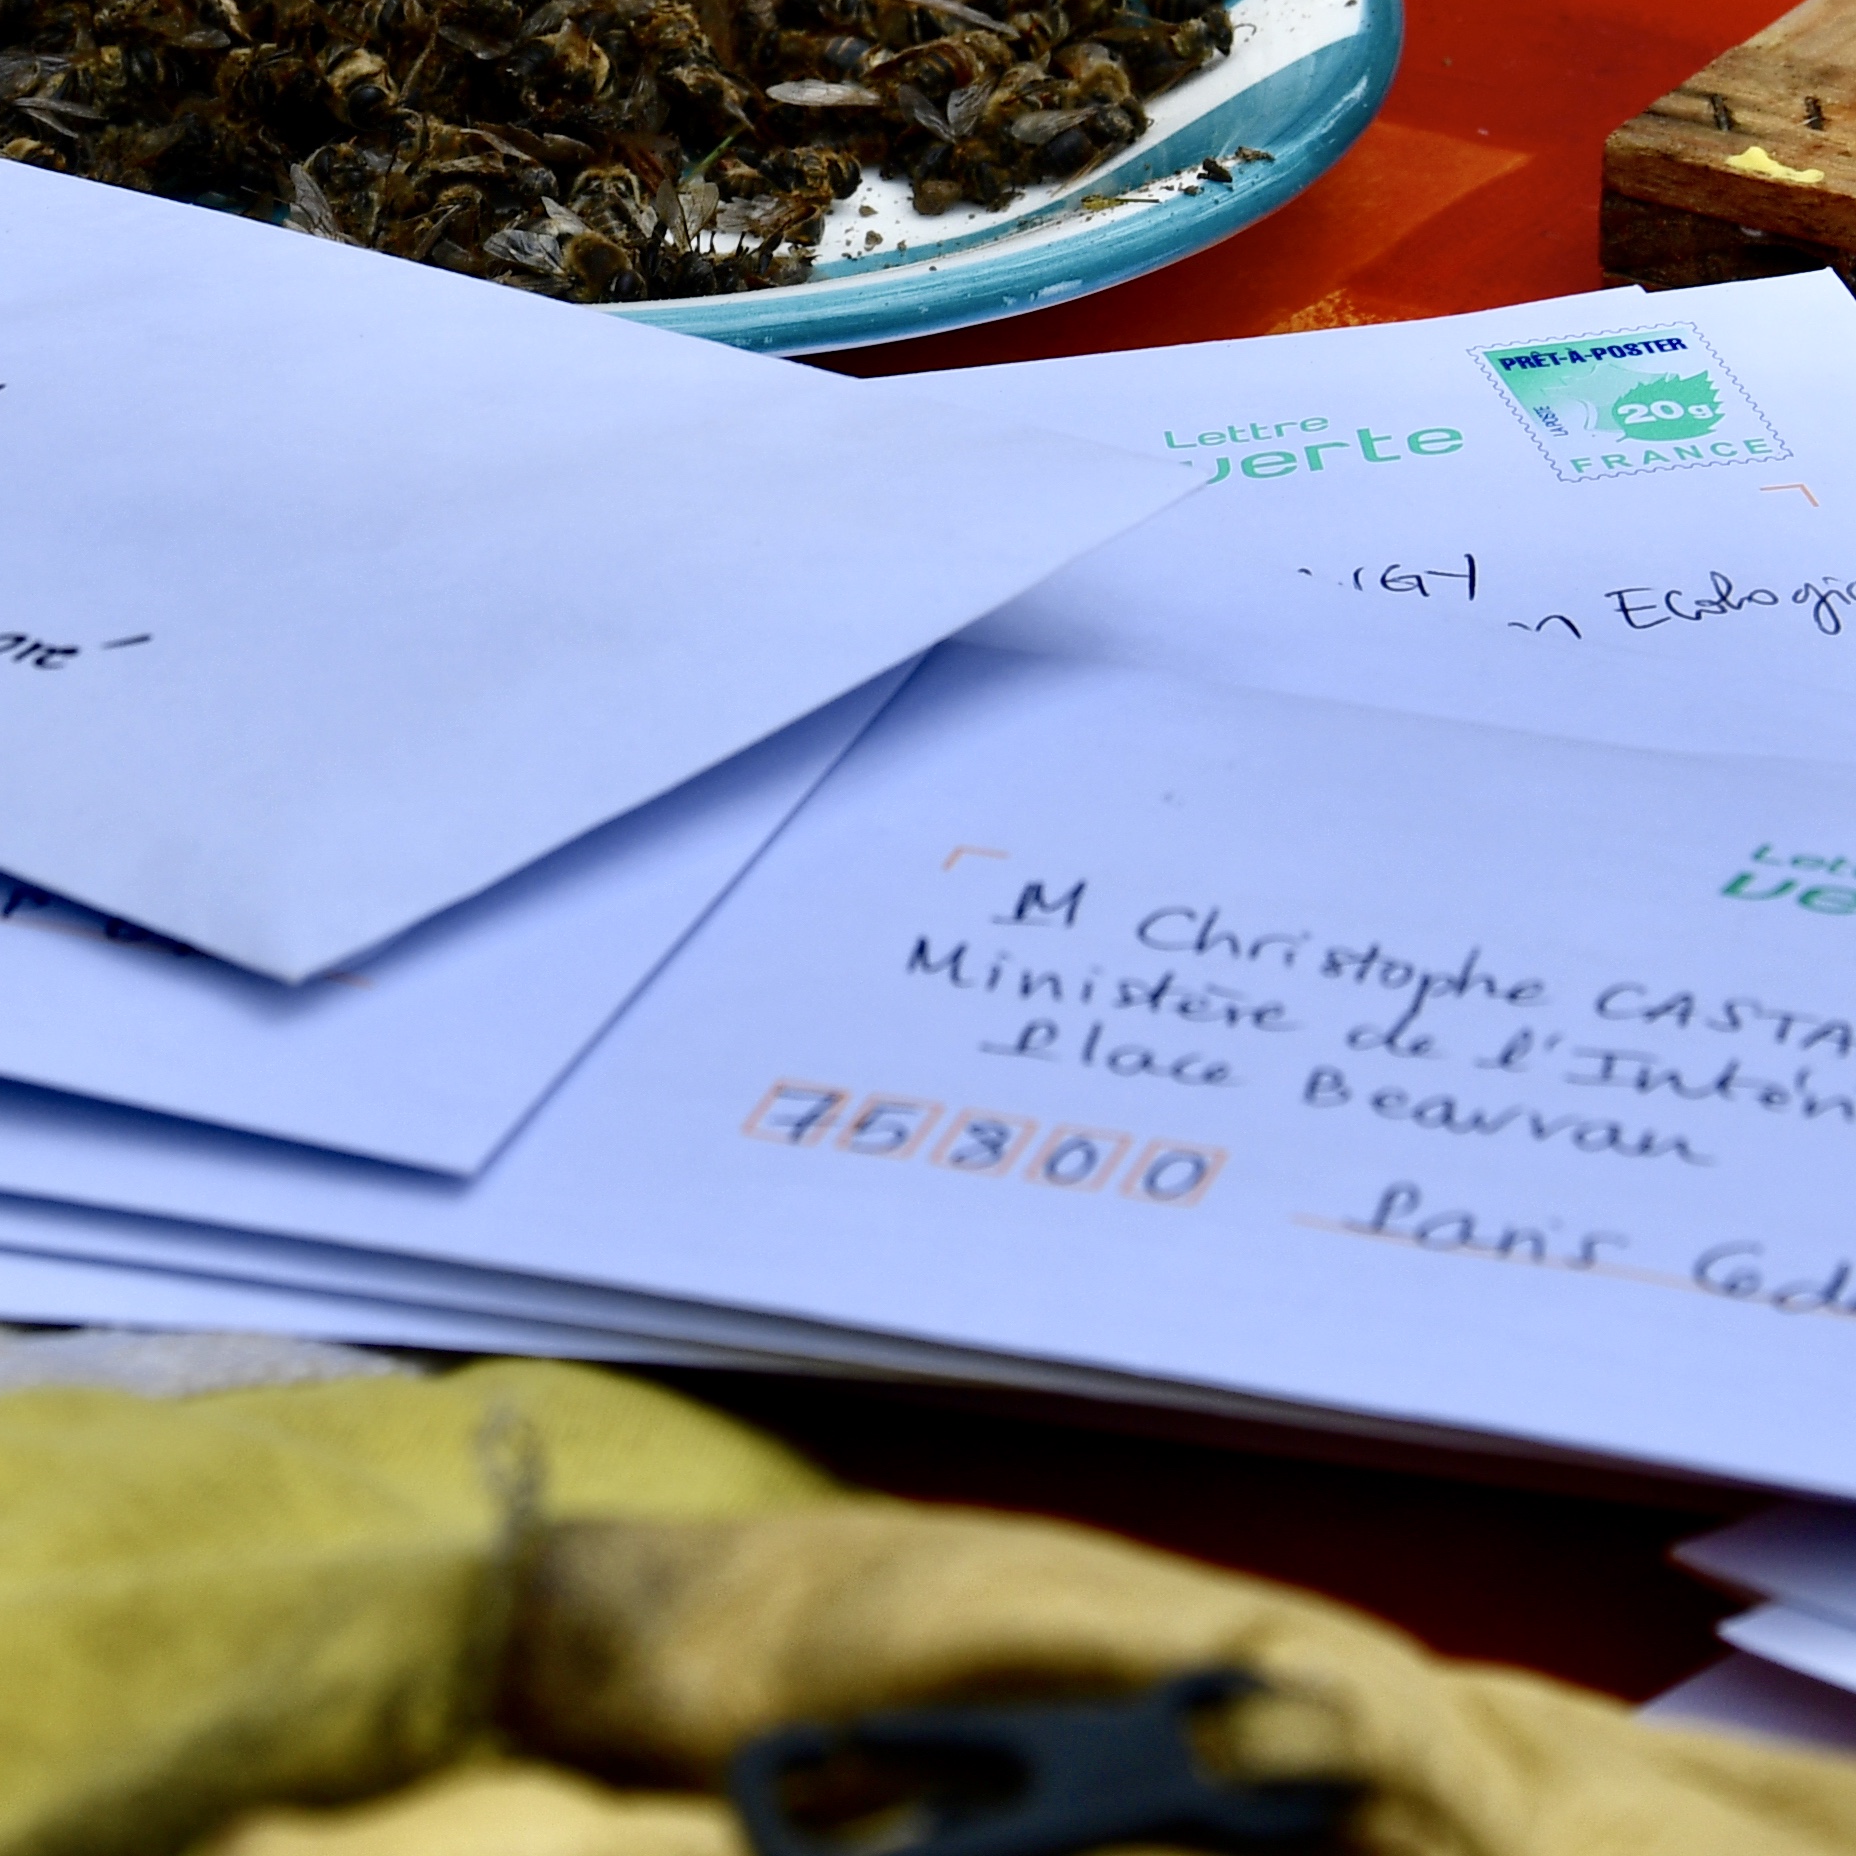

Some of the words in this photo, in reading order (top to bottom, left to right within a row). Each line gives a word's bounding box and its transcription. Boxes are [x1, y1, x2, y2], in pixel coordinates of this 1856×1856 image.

[1163, 416, 1331, 450] Lettre
[1569, 437, 1775, 474] FRANCE
[1136, 906, 1552, 1029] Christophe
[977, 1016, 1244, 1092] Place
[1344, 1012, 1446, 1062] de
[1344, 1180, 1630, 1272] Paris
